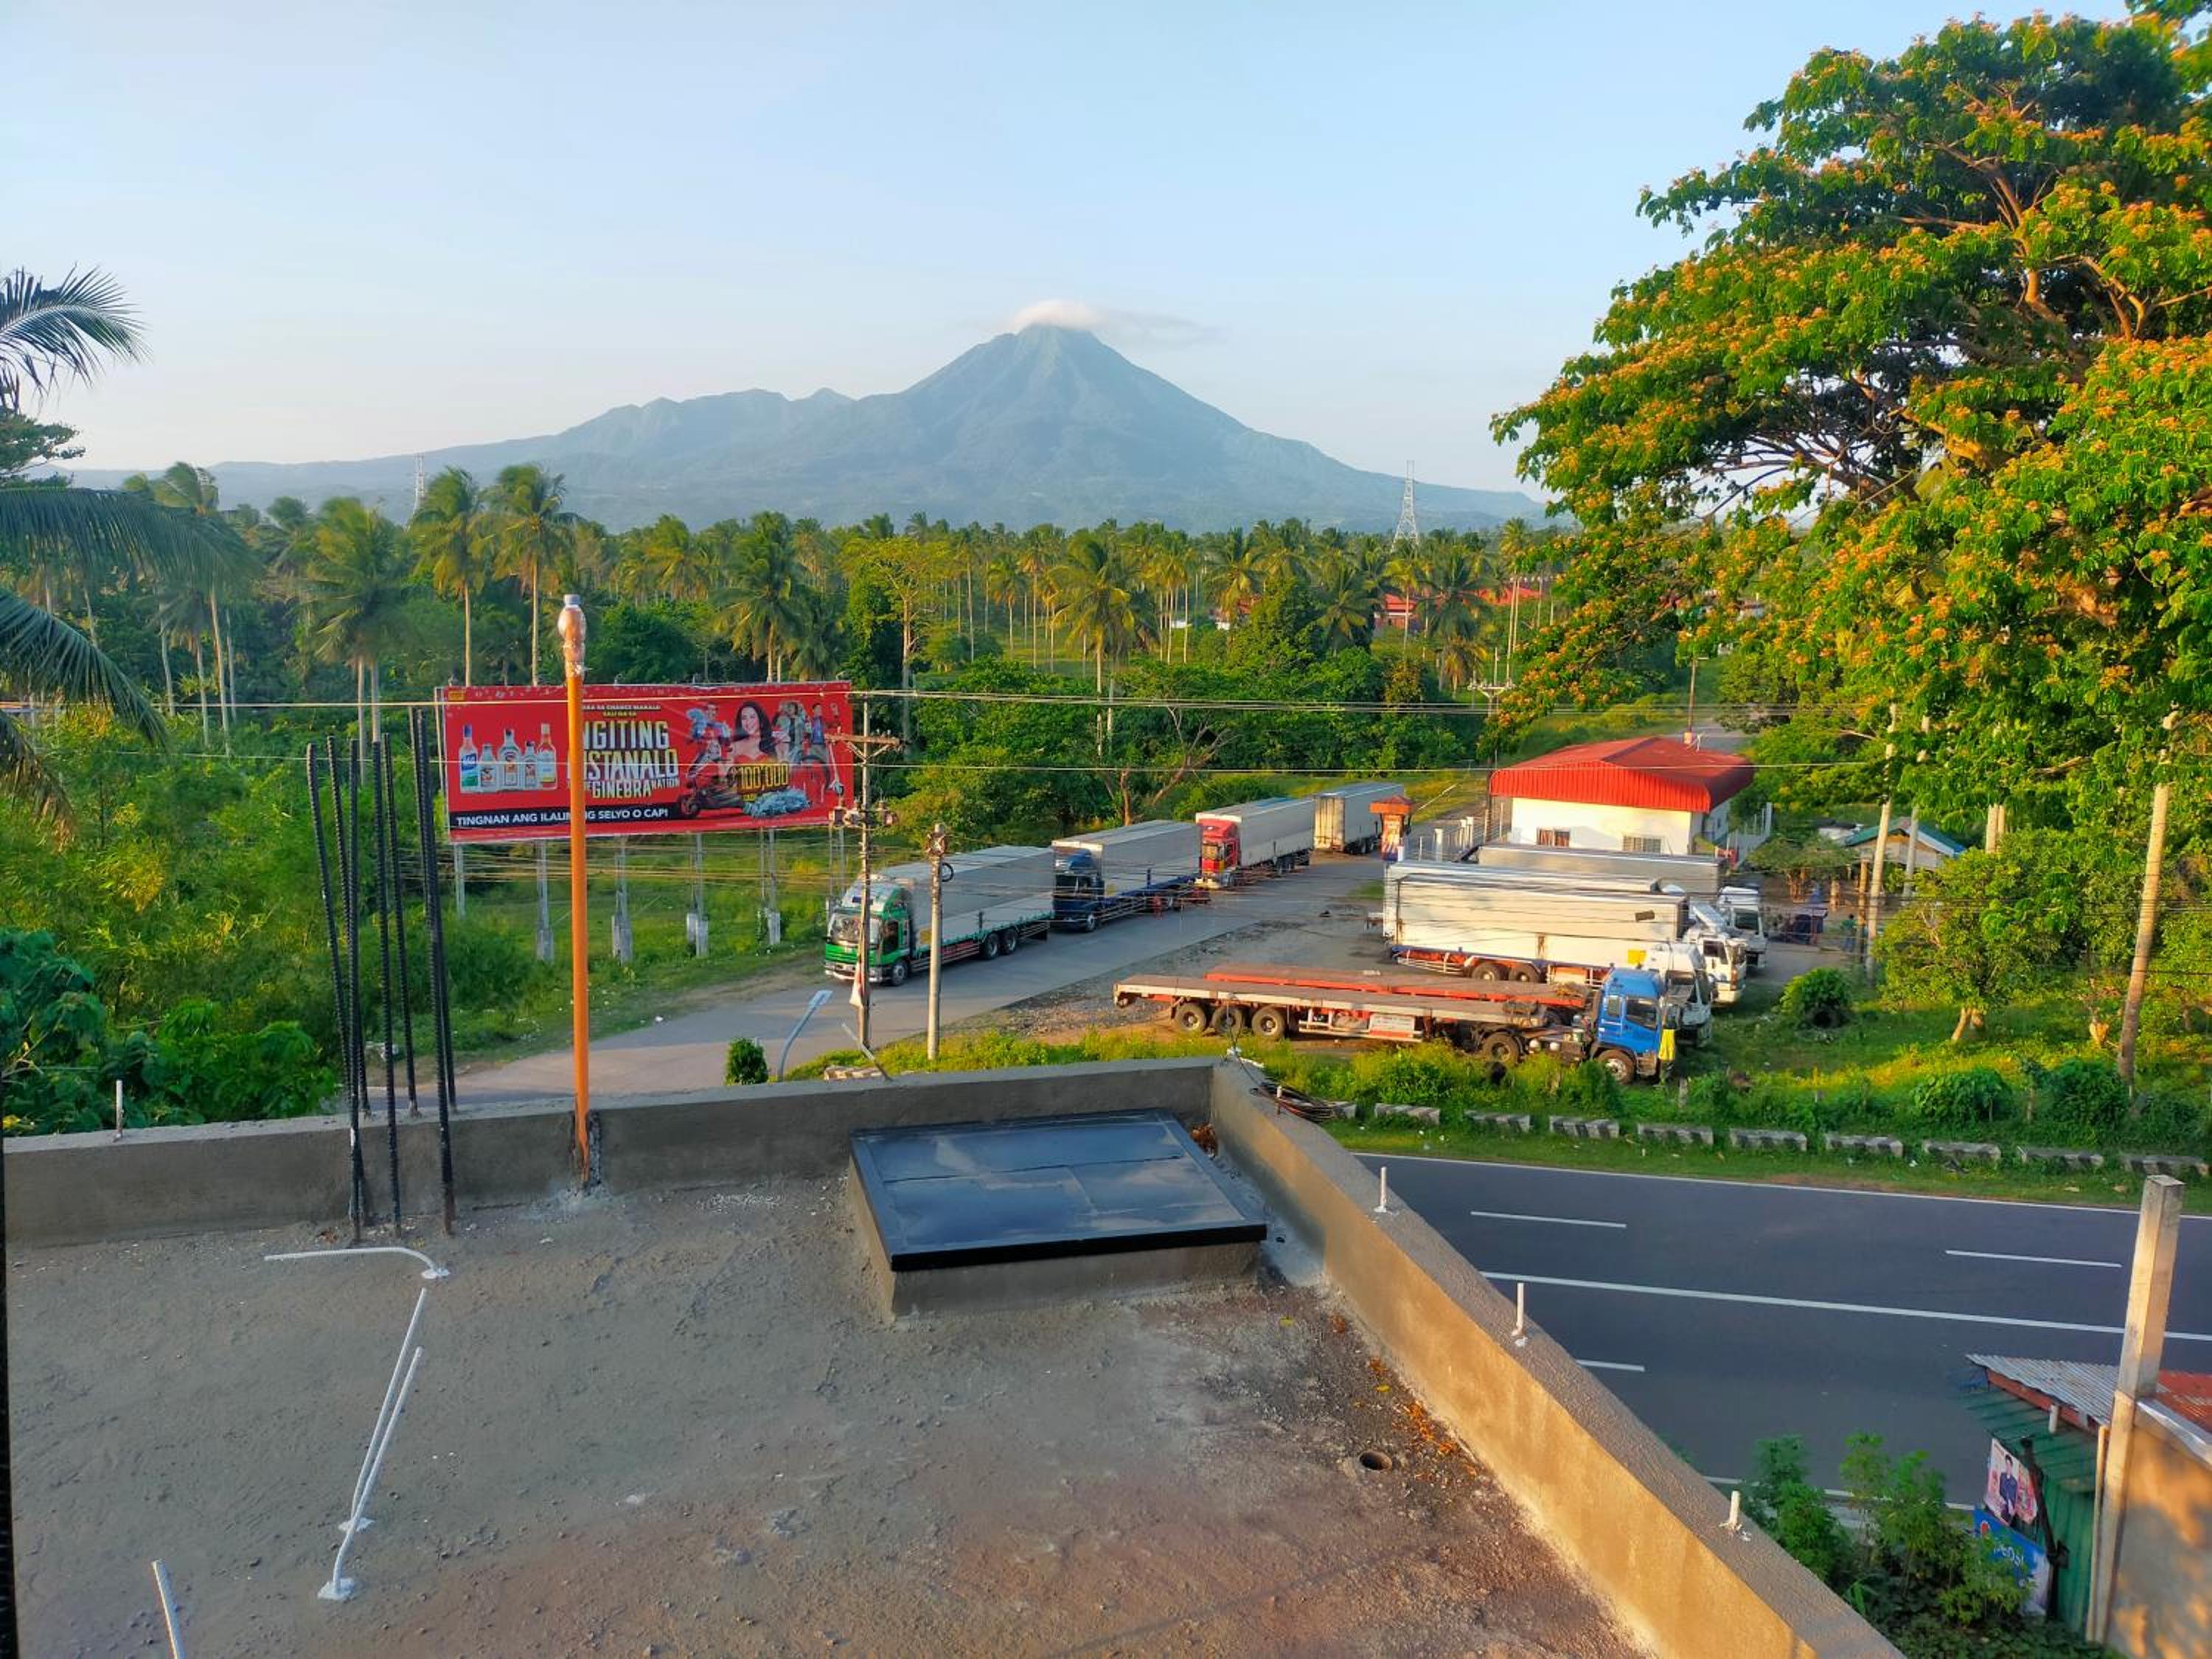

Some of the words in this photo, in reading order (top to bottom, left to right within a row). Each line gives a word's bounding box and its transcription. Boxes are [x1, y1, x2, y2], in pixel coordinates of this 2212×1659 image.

[592, 779, 652, 799] GINEBRA
[652, 778, 680, 790] NATION
[456, 814, 509, 827] TINGNAN
[512, 813, 538, 823] ANG
[599, 810, 630, 819] SELYO
[633, 810, 641, 818] O
